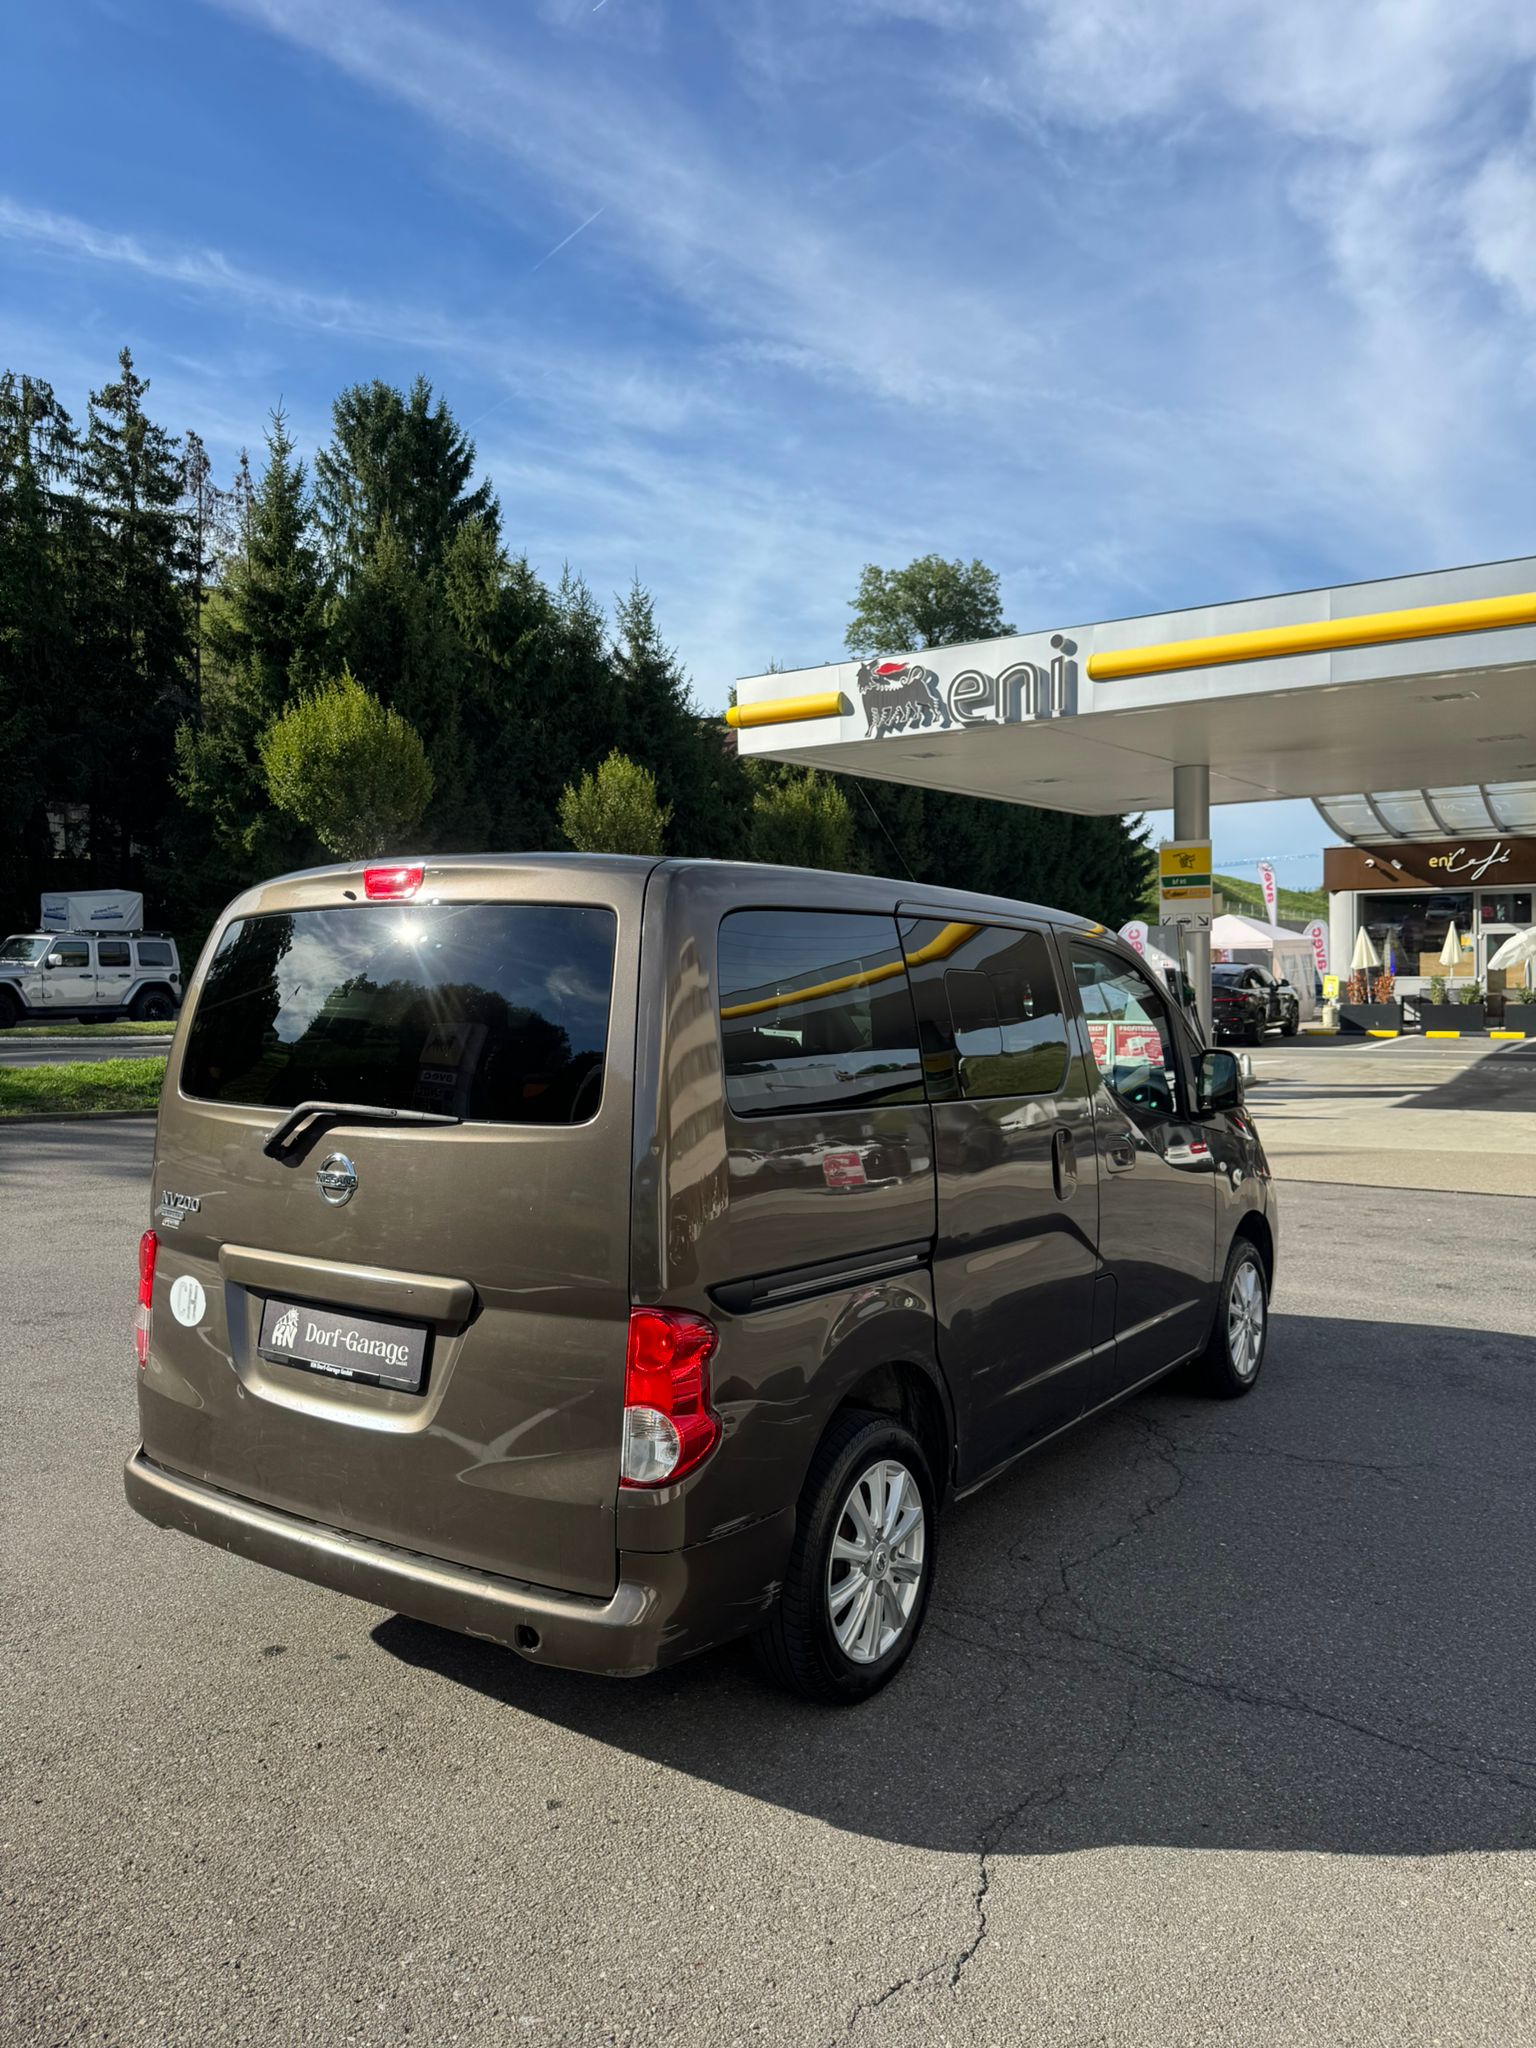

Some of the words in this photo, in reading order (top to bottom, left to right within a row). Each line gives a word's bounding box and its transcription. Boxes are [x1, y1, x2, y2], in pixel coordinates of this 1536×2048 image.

[946, 634, 1066, 722] eni
[1312, 927, 1327, 970] avec
[162, 1190, 200, 1212] NV200
[317, 1172, 356, 1187] NISSAN
[305, 1322, 408, 1365] Dorf-Garage
